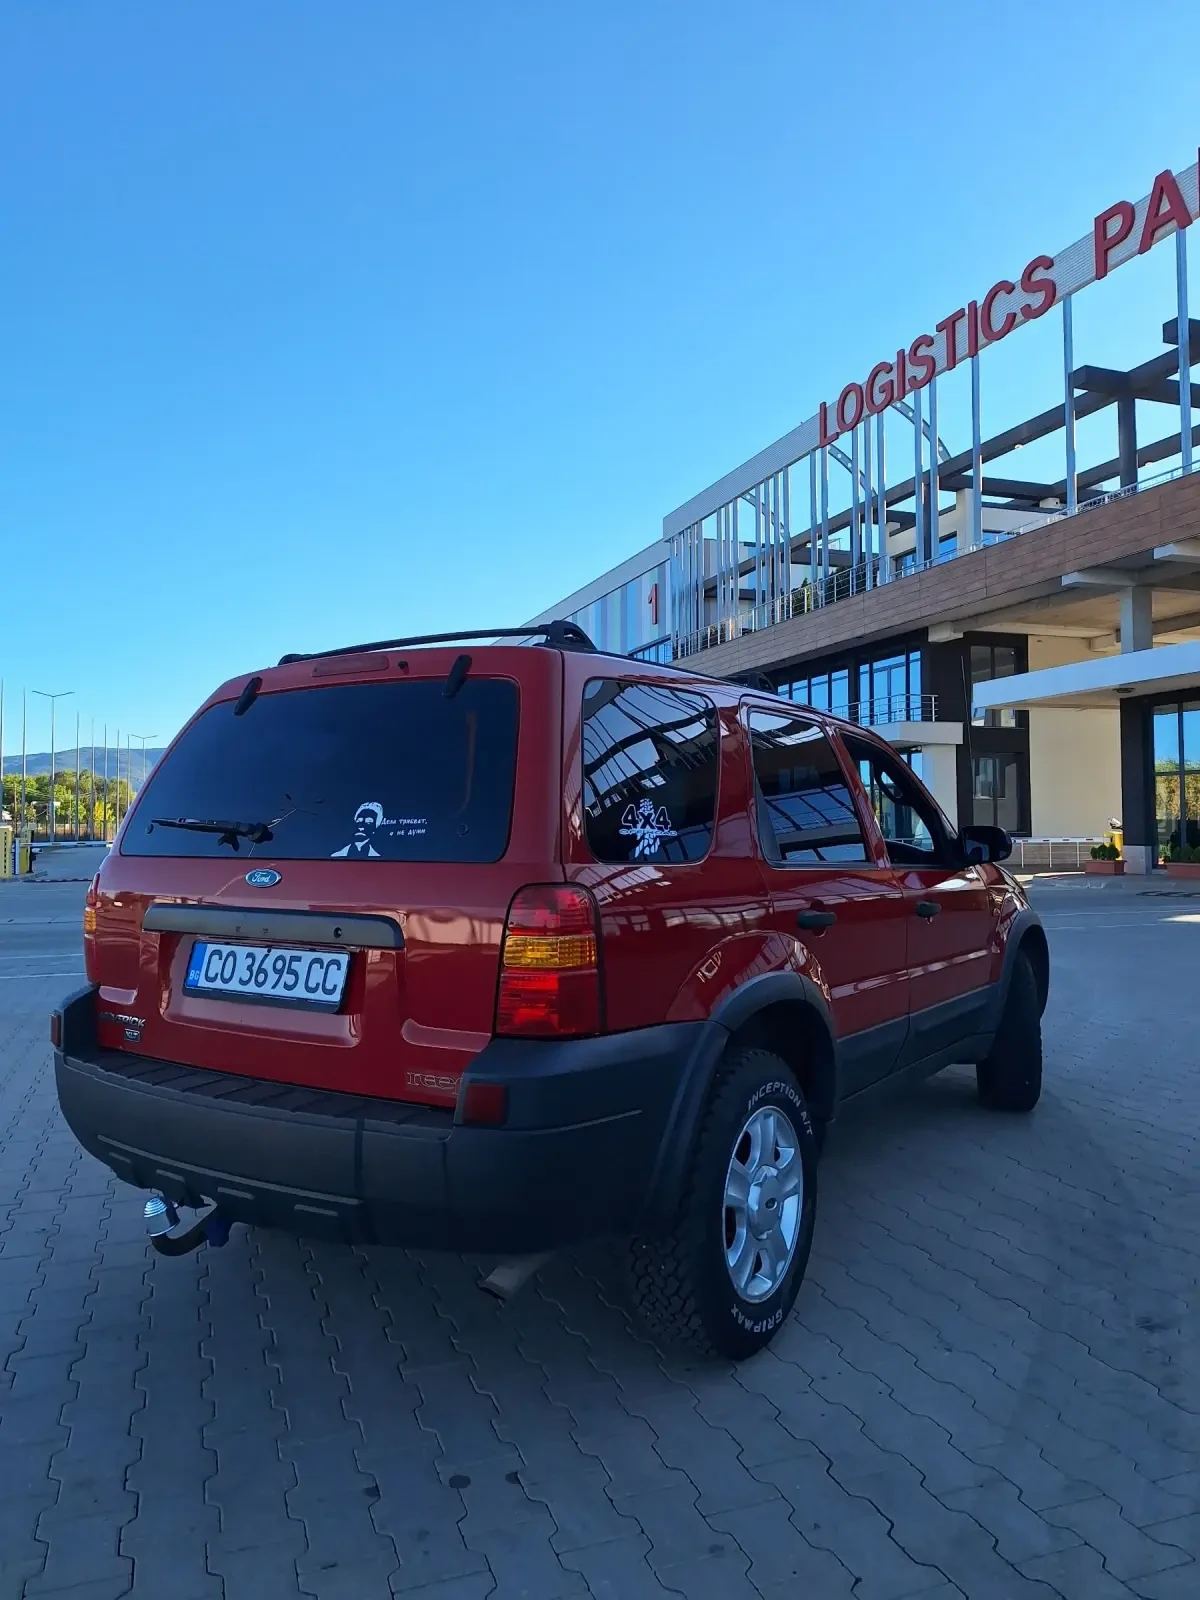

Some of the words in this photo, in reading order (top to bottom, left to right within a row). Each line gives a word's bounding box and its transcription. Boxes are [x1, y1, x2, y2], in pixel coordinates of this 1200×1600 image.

[819, 254, 1057, 448] LOGISTICS
[1094, 147, 1200, 280] PA
[647, 583, 658, 625] 1
[748, 1081, 801, 1111] INCEPTION
[730, 1303, 783, 1333] GRIPMAX
